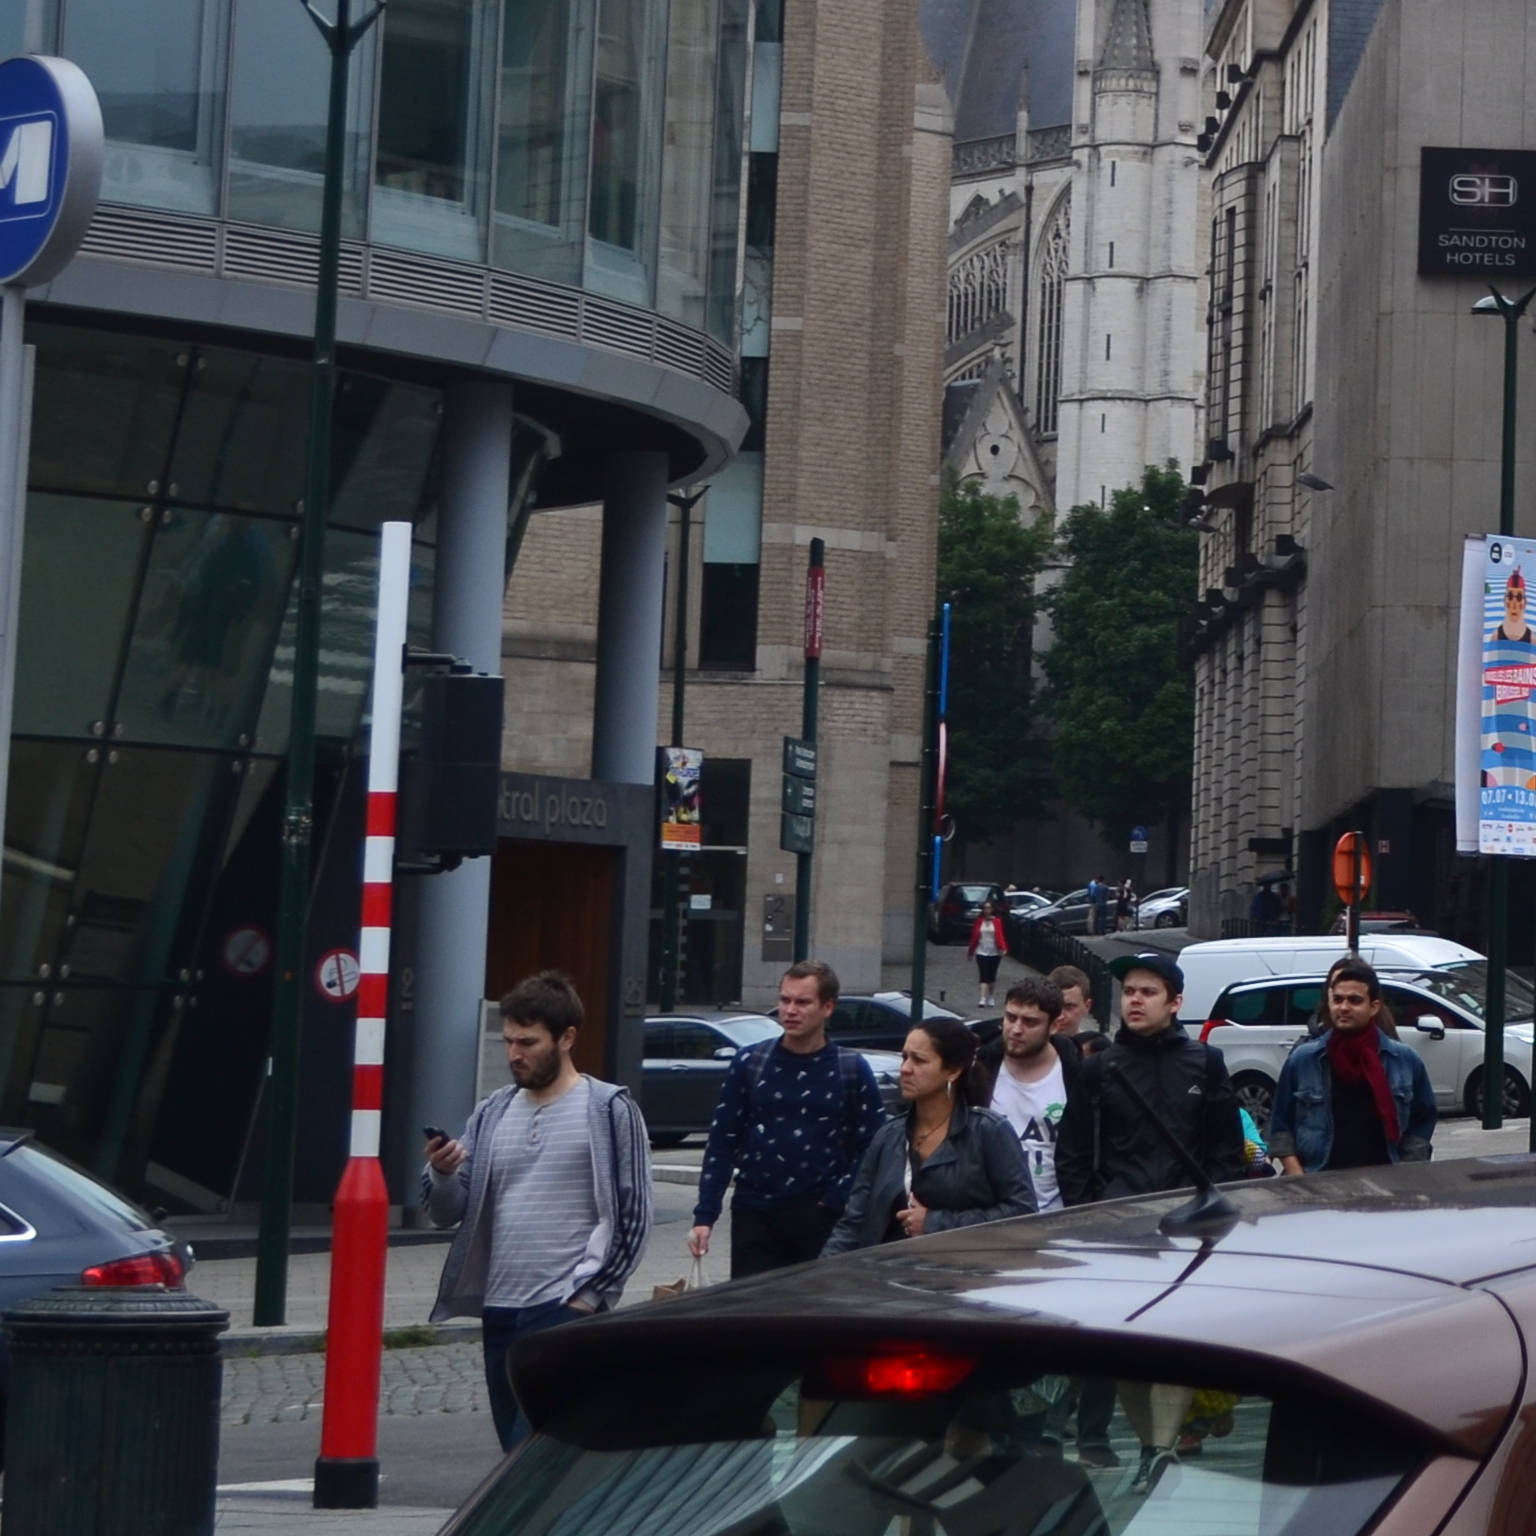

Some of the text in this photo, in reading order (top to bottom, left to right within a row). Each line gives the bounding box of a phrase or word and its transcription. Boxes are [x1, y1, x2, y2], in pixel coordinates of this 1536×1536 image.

[1453, 177, 1514, 203] SH
[1438, 234, 1527, 249] SANDTON
[1446, 252, 1517, 266] HOTELS
[544, 783, 608, 836] plaza
